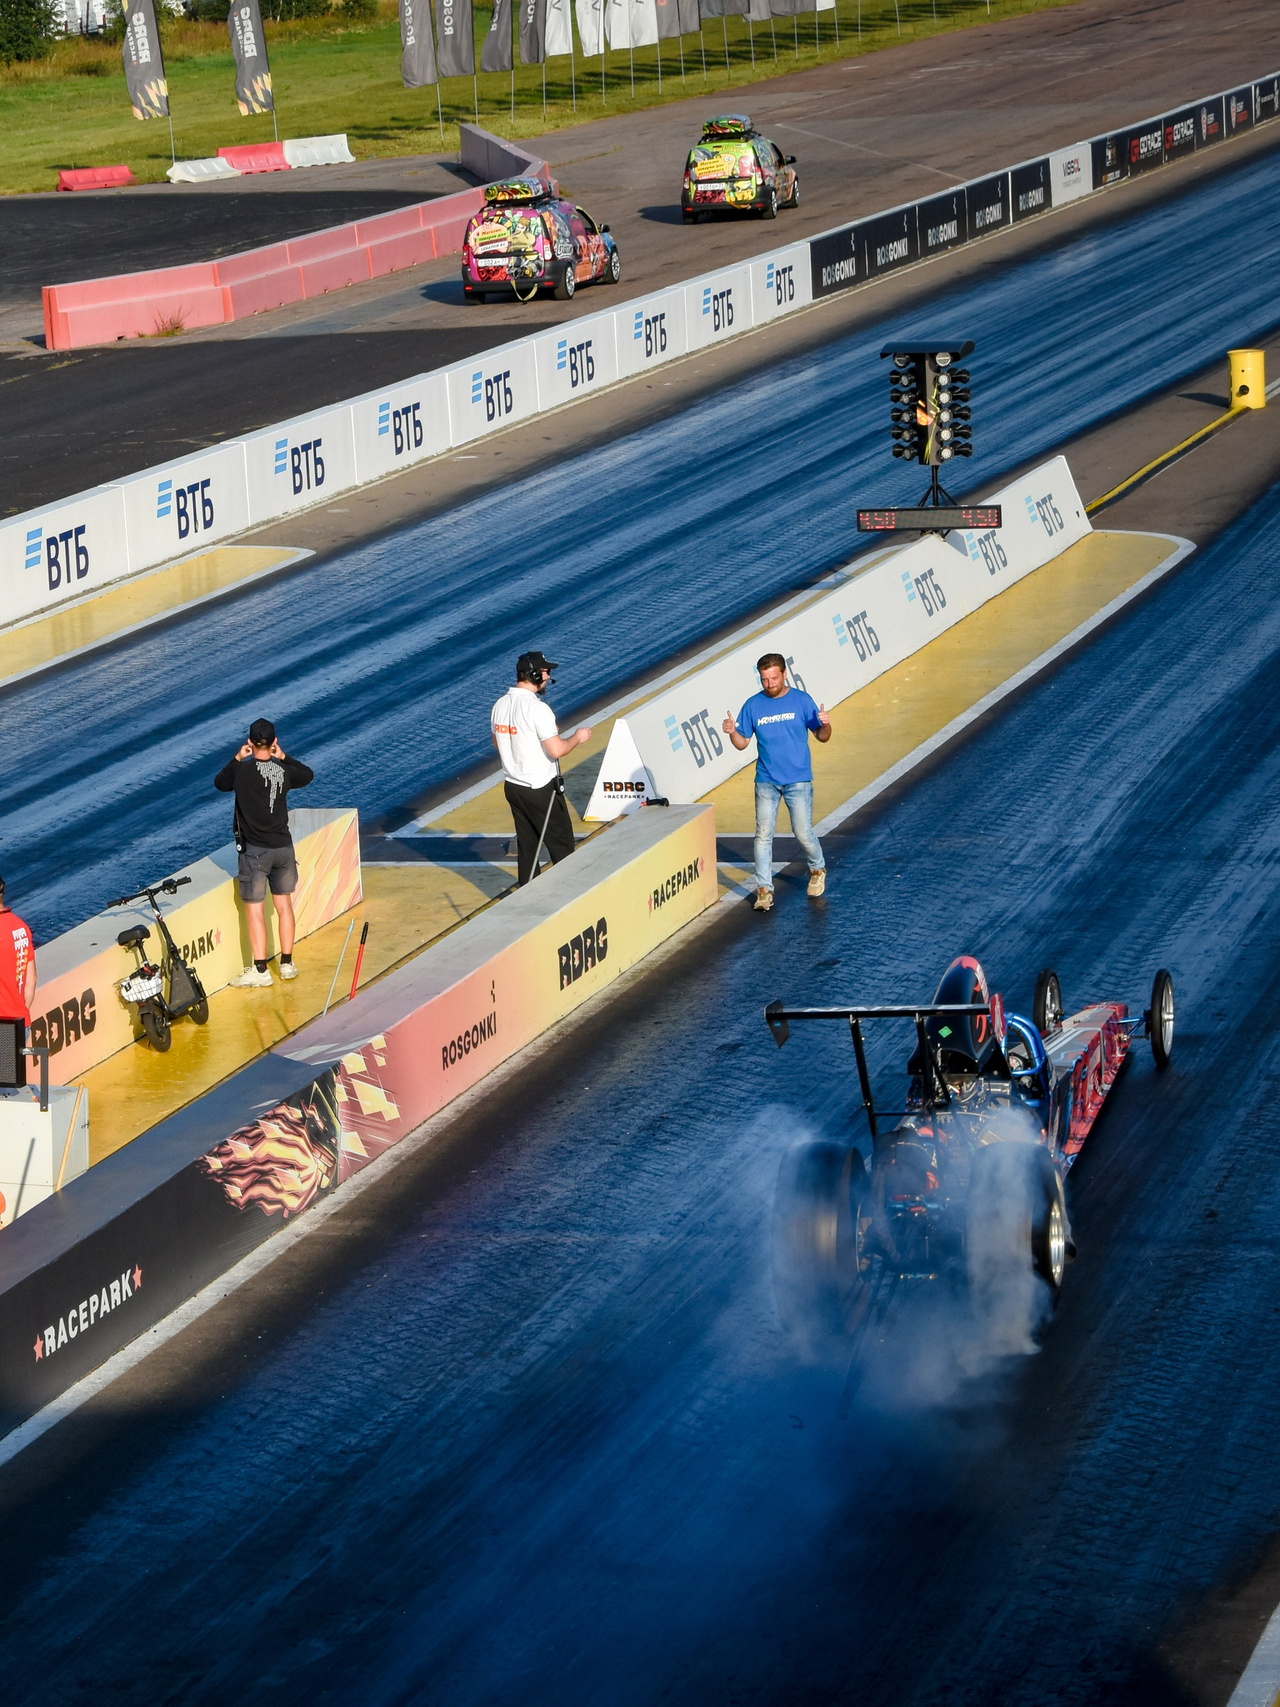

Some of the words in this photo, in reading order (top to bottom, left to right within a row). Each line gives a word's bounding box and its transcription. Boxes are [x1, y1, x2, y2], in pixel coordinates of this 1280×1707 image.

[975, 202, 1002, 229] ROSGONKI
[1019, 187, 1044, 211] ROSGONKI
[877, 237, 908, 266] ROSGONKI
[927, 219, 958, 247] ROSGONKI
[775, 265, 795, 306] ВТБ
[822, 257, 856, 287] ROSGONKI
[713, 289, 734, 332] ВТБ
[645, 313, 667, 358] ВТБ
[569, 340, 595, 388] ВТБ
[485, 370, 513, 422] ВТБ
[393, 402, 423, 456] ВТБ
[291, 438, 325, 495] ВТБ
[176, 478, 214, 540] ВТБ
[1036, 493, 1064, 538] ВТБ
[47, 524, 89, 591] ВТБ
[978, 529, 1008, 576] ВТБ
[915, 568, 947, 617] ВТБ
[847, 610, 880, 662] ВТБ
[681, 709, 723, 768] ВТБ
[603, 781, 645, 792] RDRC
[652, 857, 701, 910] RACEPARK
[557, 916, 608, 991] RDRC
[441, 1011, 497, 1071] ROSGONKI
[44, 1268, 133, 1356] RACEPARK
